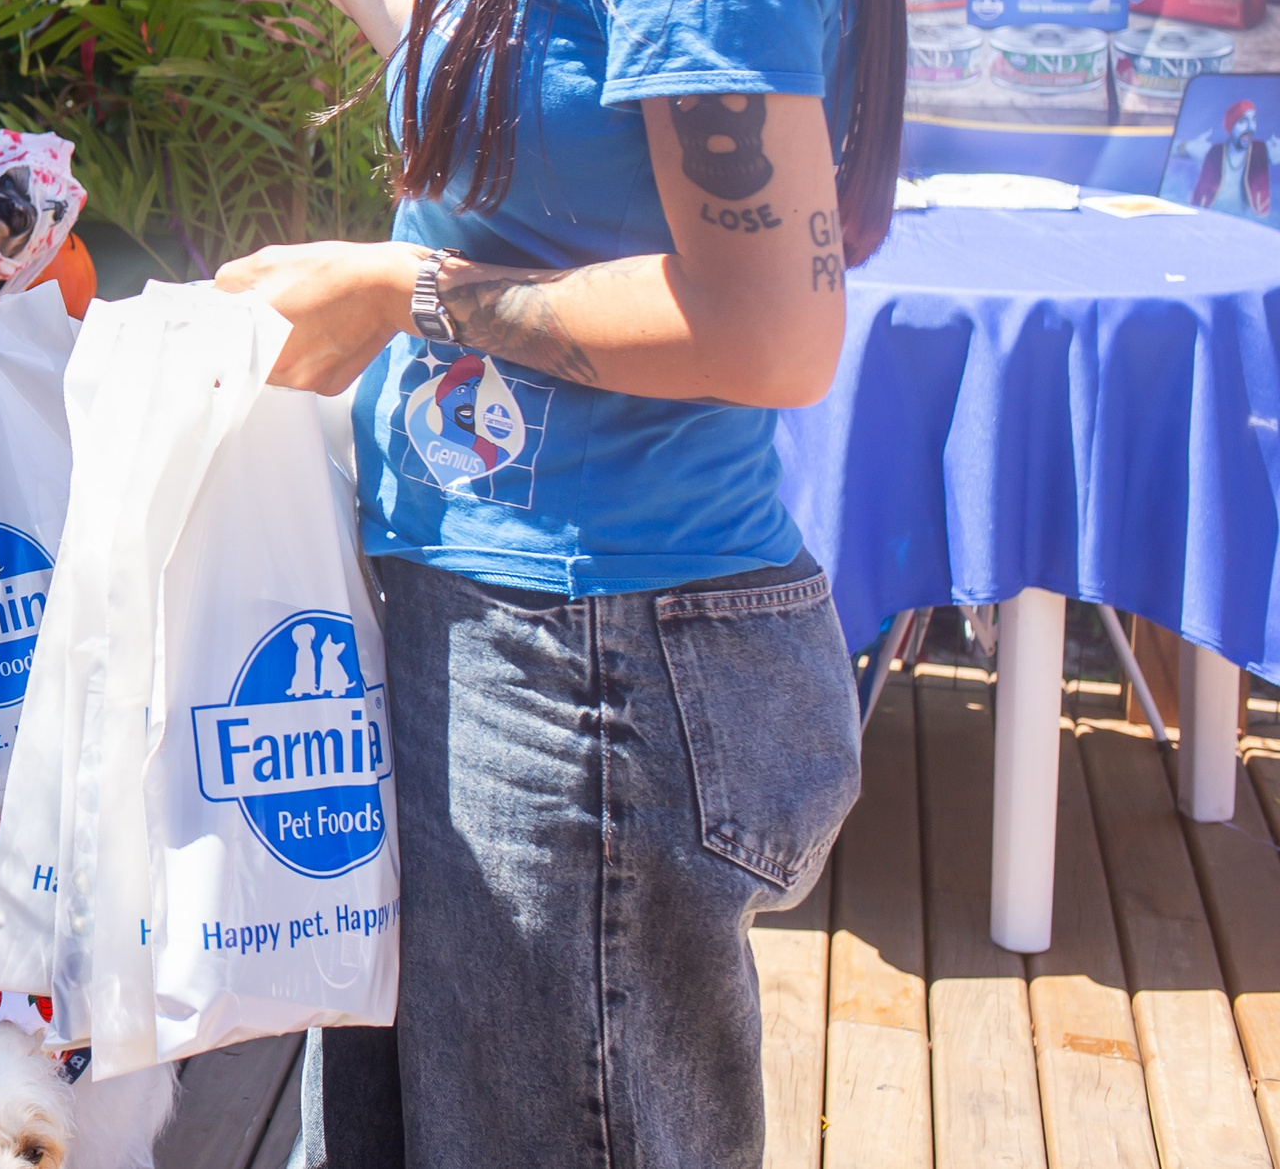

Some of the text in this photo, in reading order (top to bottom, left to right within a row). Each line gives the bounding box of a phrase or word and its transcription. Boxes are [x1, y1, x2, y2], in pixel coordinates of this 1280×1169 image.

[701, 203, 782, 234] LOSE
[278, 803, 381, 841] Pet Foods
[202, 921, 280, 955] Happy
[290, 911, 329, 948] pet.
[336, 901, 390, 936] Happy
